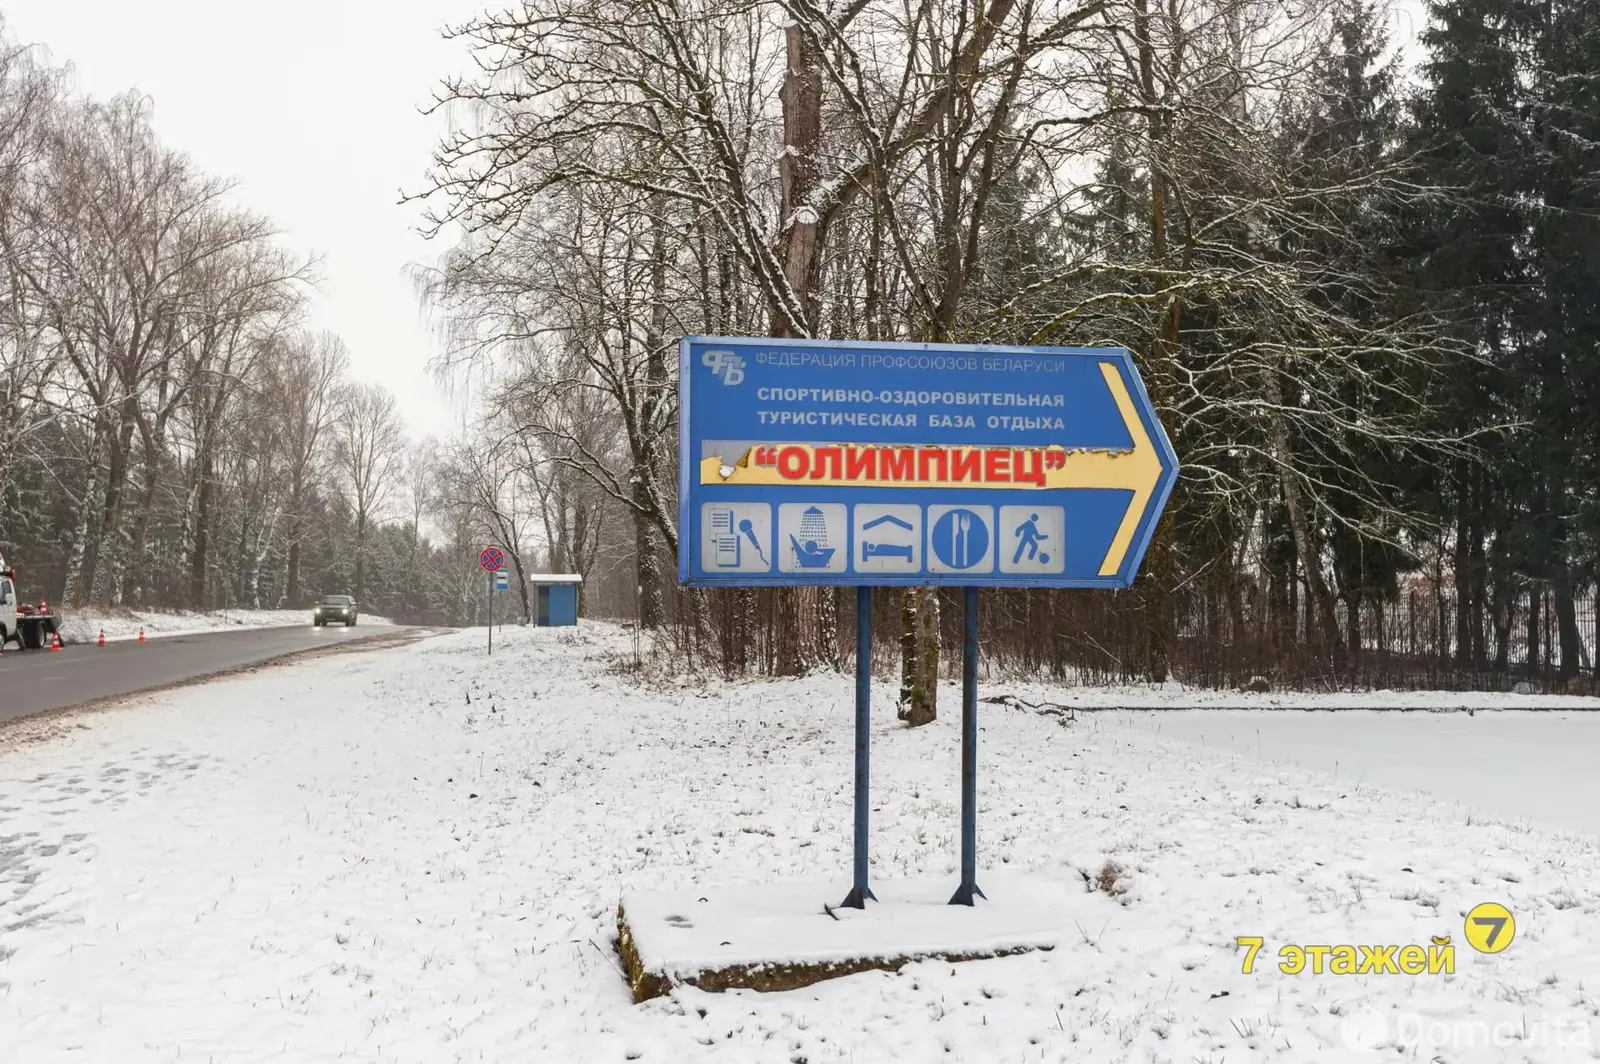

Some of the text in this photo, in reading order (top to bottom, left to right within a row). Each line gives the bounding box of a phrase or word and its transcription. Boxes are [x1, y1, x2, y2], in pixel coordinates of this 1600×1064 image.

[755, 351, 1066, 373] ФЕДЕРАЦИЯ ПРОФСОЮЗОВ БЕЛАРУСИ
[756, 387, 1066, 408] СПОРТИВНО-ОЗДОРОВИТЕЛЬНАЯ
[757, 410, 1066, 431] ТУРИСТИЧЕСКАЯ БАЗА ОТДЫХА
